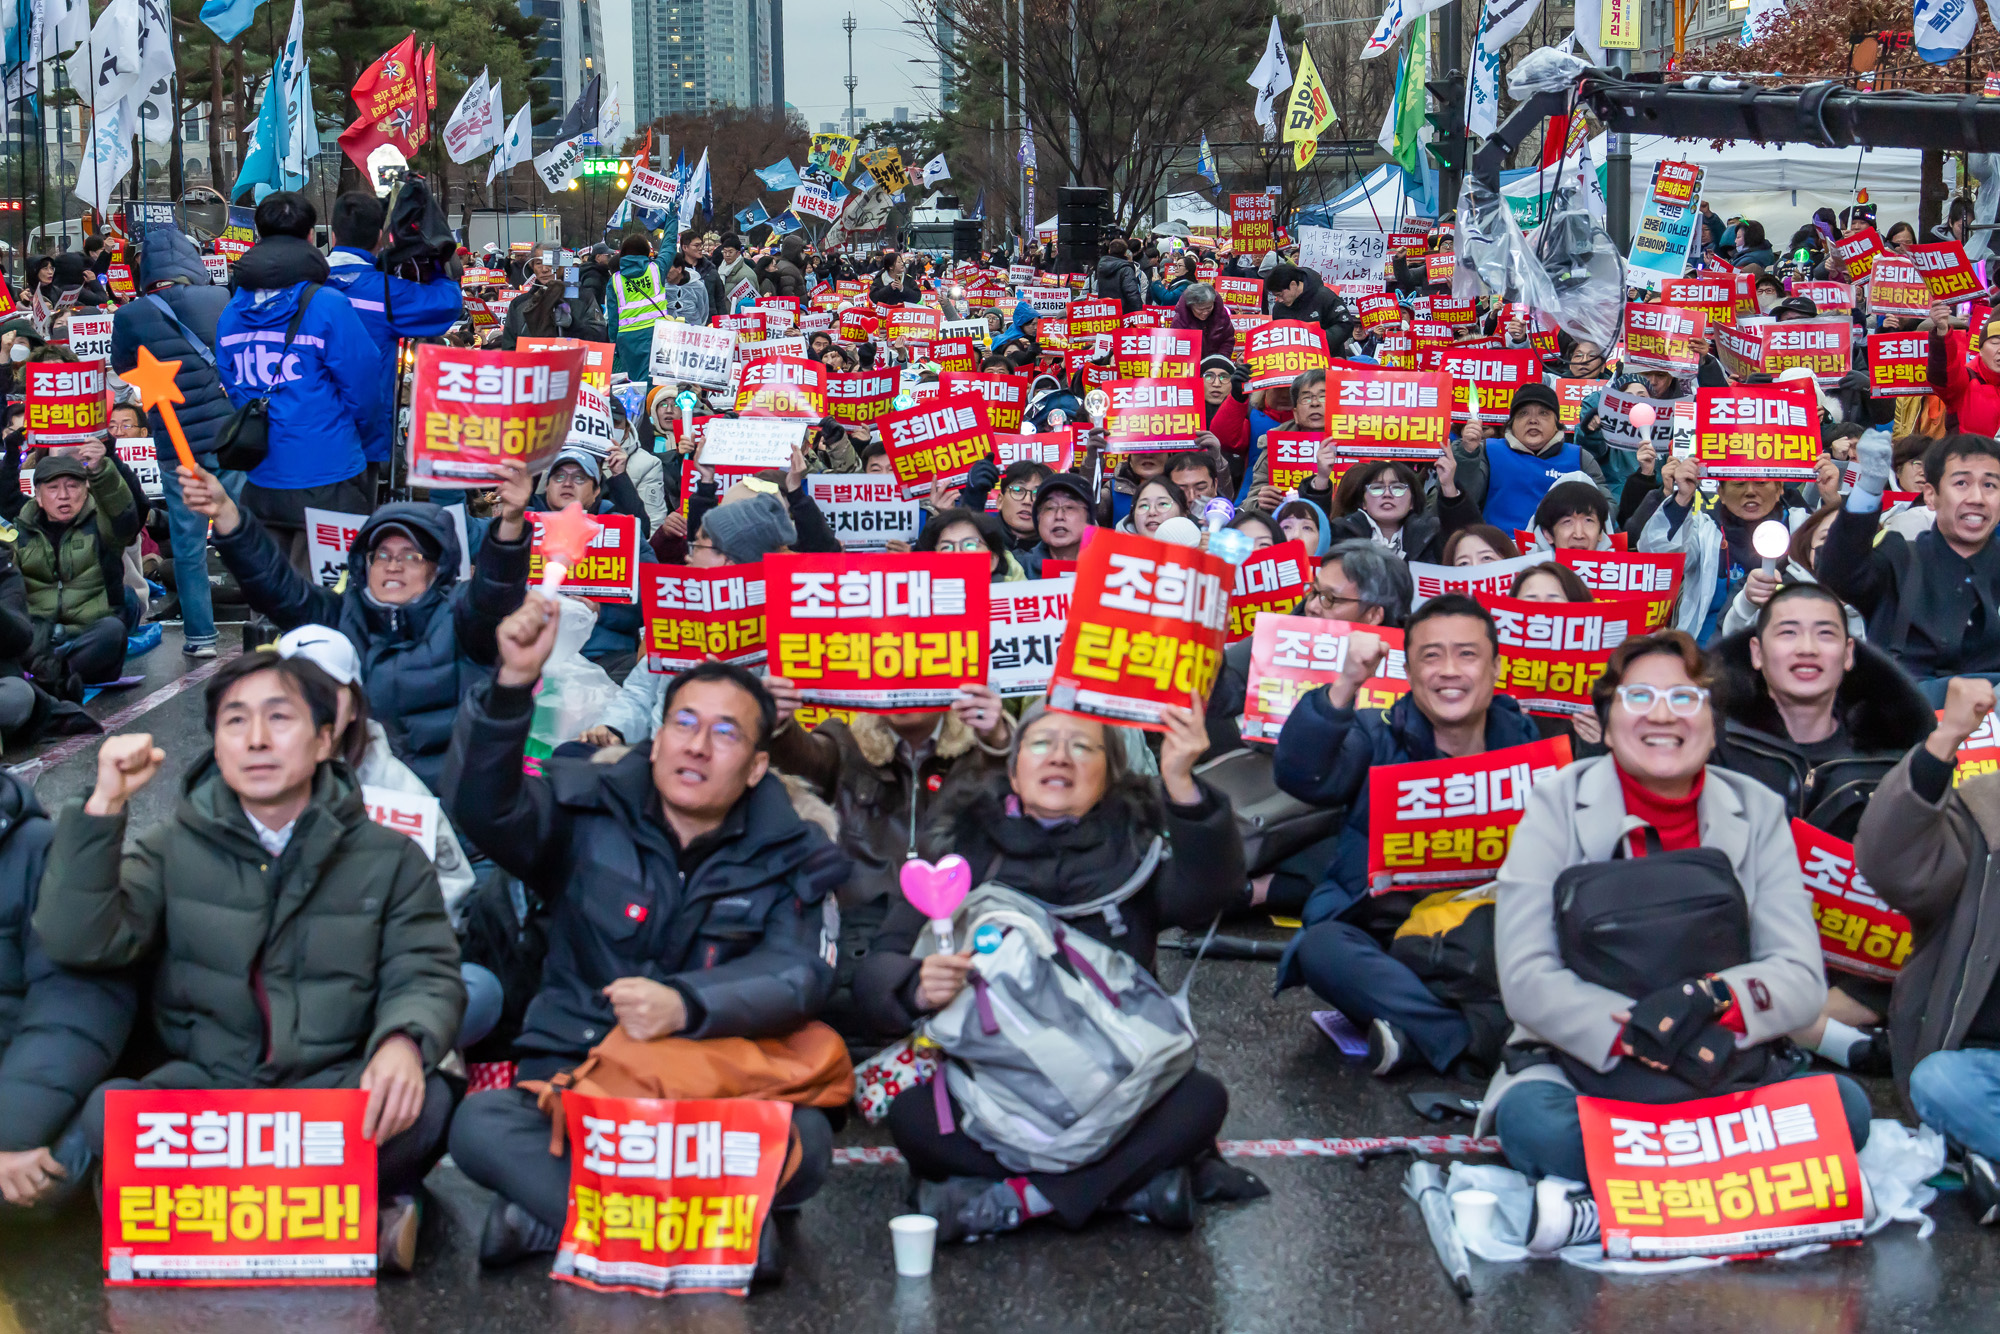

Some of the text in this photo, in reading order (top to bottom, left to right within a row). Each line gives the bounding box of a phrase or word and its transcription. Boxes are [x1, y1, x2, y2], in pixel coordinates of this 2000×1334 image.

[636, 168, 680, 194] 특별재판부
[1661, 164, 1693, 181] 조희대를
[1655, 179, 1691, 199] 탄핵하라!
[797, 194, 841, 224] 내란척결!
[1235, 196, 1255, 208] 내란당은
[1239, 222, 1269, 237] 내란당이
[1643, 217, 1691, 238] 관중이 아니라
[1254, 238, 1276, 252] 때까지
[1347, 235, 1385, 259] 종신형
[1393, 237, 1423, 245] 조희대를
[1636, 235, 1687, 256] 플레이어입니다
[1406, 248, 1428, 258] 하라!
[1846, 250, 1883, 278] 하라!
[1875, 262, 1923, 283] 조희대를
[1032, 290, 1070, 300] 특별재판부
[1221, 280, 1258, 291] 조희대를
[1670, 285, 1728, 301] 조희대를
[1869, 286, 1931, 307] 탄핵하라!
[1928, 272, 1978, 298] 하라!
[760, 300, 795, 311] 조희대를
[1073, 300, 1116, 318] 조희대를
[1359, 295, 1394, 312] 조희대를
[1434, 297, 1471, 309] 조희대를
[1706, 306, 1732, 323] 하라!
[472, 313, 495, 323] 하라!
[718, 317, 760, 331] 조희대를
[765, 315, 793, 328] 재판부
[892, 311, 934, 324] 조희대를
[1071, 317, 1120, 335] 탄핵하라!
[1362, 310, 1402, 329] 탄핵하라!
[1431, 311, 1473, 322] 탄핵하라!
[1631, 307, 1694, 336] 조희대를
[71, 320, 113, 338] 특별재
[735, 330, 763, 344] 하라!
[889, 327, 936, 341] 탄핵하라!
[1042, 322, 1067, 335] 조희
[1250, 324, 1321, 350] 조희대를
[1413, 324, 1453, 338] 조희대를
[1770, 330, 1839, 349] 조희대를
[934, 342, 968, 358] 조희대를
[1122, 334, 1190, 357] 조희대를
[1880, 334, 1928, 359] 조희
[743, 361, 817, 388] 조희대를
[944, 359, 972, 372] 하라!
[1248, 352, 1328, 379] 탄핵하라!
[1445, 358, 1517, 381] 조희대를
[1765, 355, 1844, 377] 탄핵하라!
[34, 371, 104, 396] 조희대를
[437, 362, 568, 404] 조희대를
[827, 378, 892, 398] 조희대를
[1340, 381, 1437, 407] 조희대를
[575, 390, 612, 421] 재판부
[734, 389, 823, 416] 탄핵하라!
[1113, 384, 1193, 411] 조희대를
[987, 407, 1022, 428] 하라!
[1709, 398, 1807, 426] 조희대를
[890, 405, 976, 446] 조희대를
[1105, 411, 1200, 438] 탄핵하라!
[1329, 414, 1443, 441] 탄핵하라!
[893, 433, 990, 482] 탄핵하라!
[1277, 440, 1320, 463] 조희
[1702, 433, 1818, 460] 탄핵하라!
[529, 554, 625, 584] 탄하라!
[1229, 556, 1300, 595] 대를
[1572, 561, 1672, 592] 조희대를
[656, 577, 766, 611] 조희대를
[791, 571, 965, 618] 조희대를
[1101, 550, 1232, 628] 조희대를
[989, 595, 1069, 626] 특별재
[1492, 609, 1627, 650] 조희대를
[780, 631, 978, 681] 탄핵하라!
[1270, 628, 1406, 682] 조희를
[1383, 825, 1520, 871] 탄핵하
[135, 1112, 344, 1168] 조희대를
[584, 1118, 760, 1179] 조희대를
[1611, 1105, 1818, 1169] 조희대를
[1607, 1153, 1847, 1228] 탄핵하라!
[120, 1185, 359, 1241] 탄핵하라!
[571, 1188, 758, 1254] 탄핵하라!
